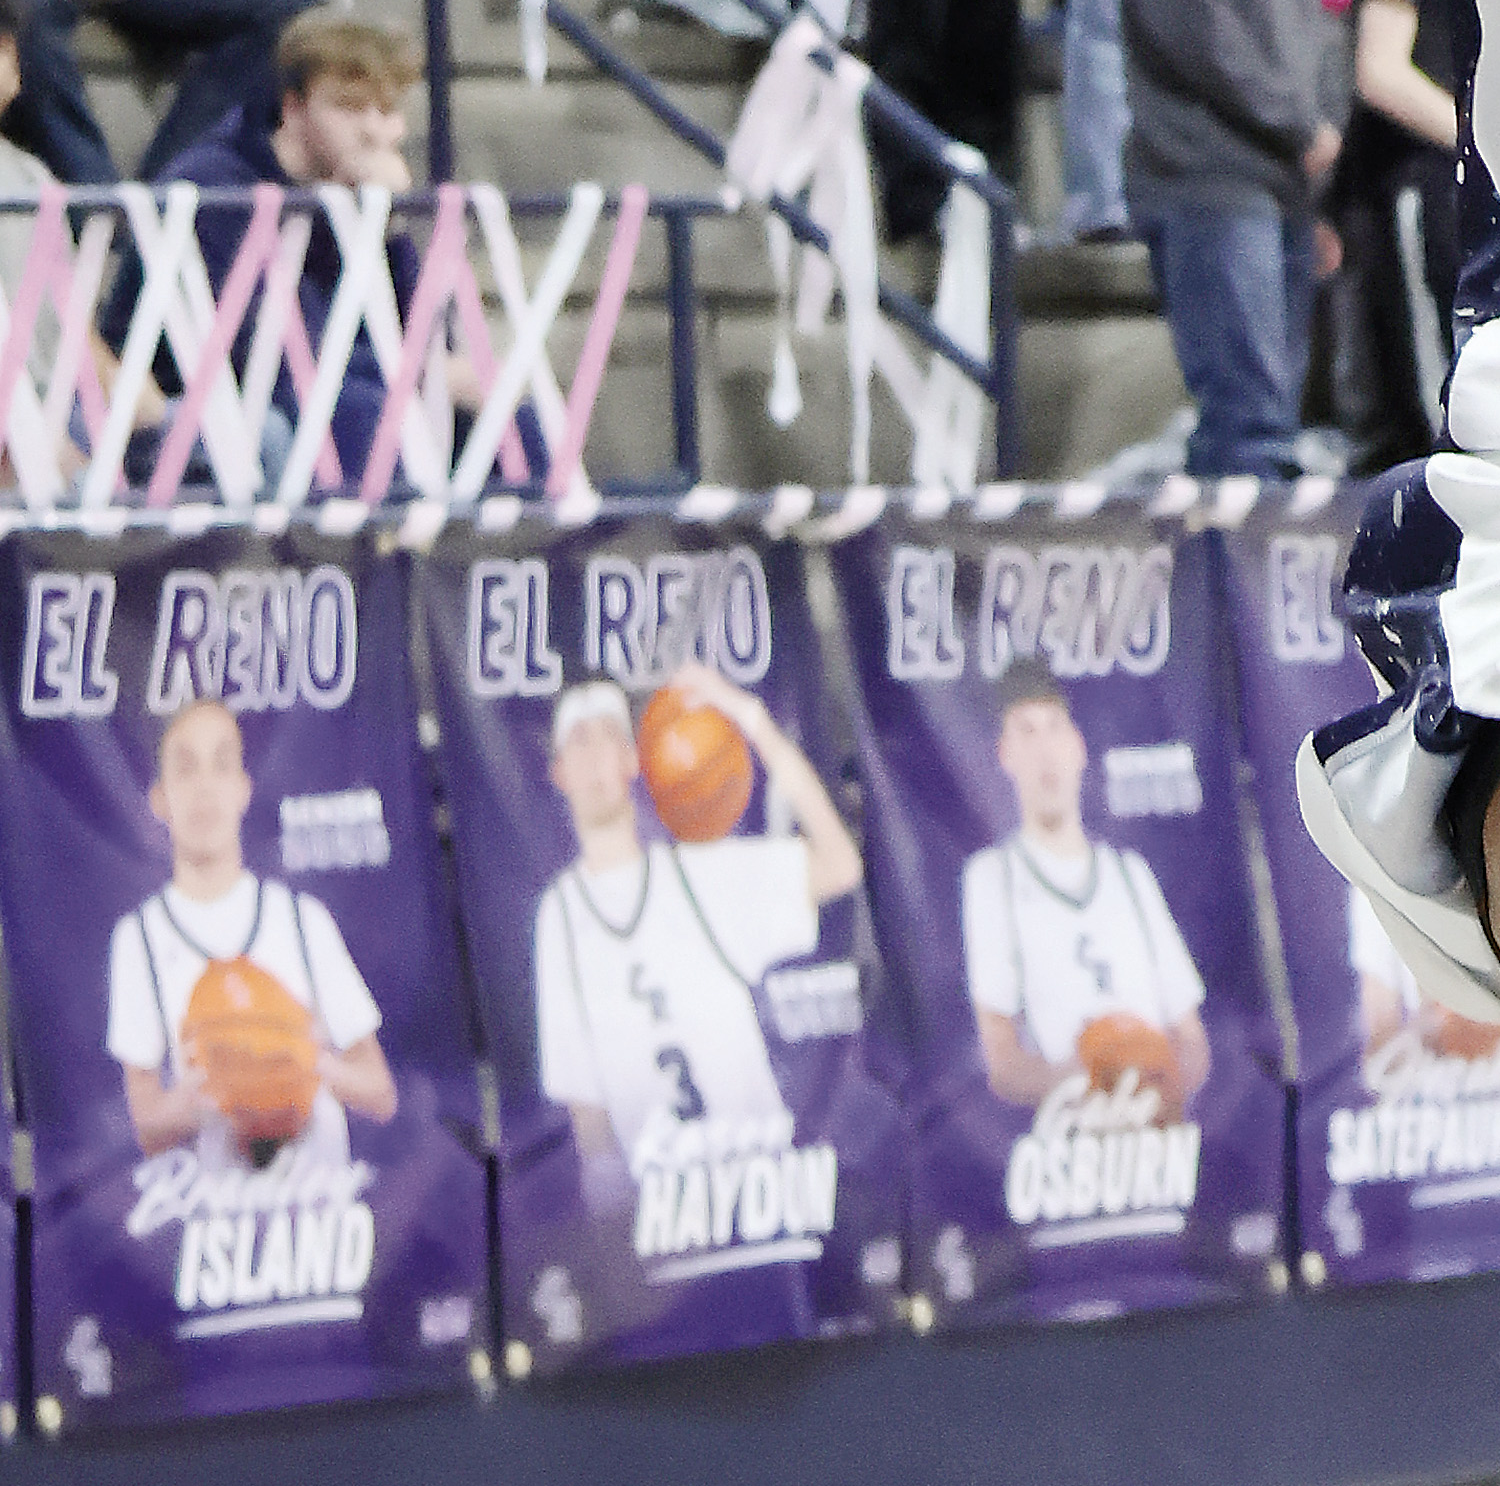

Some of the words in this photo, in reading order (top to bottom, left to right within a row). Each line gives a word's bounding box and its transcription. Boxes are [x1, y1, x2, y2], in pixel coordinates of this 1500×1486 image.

[20, 569, 119, 719] EL
[147, 564, 358, 715] RENO
[468, 557, 563, 697] EL
[585, 544, 772, 694] REO
[887, 544, 964, 681] EL
[1268, 533, 1345, 662] EL
[1004, 1120, 1202, 1225] OSBURN
[173, 1201, 376, 1312] ISLAND
